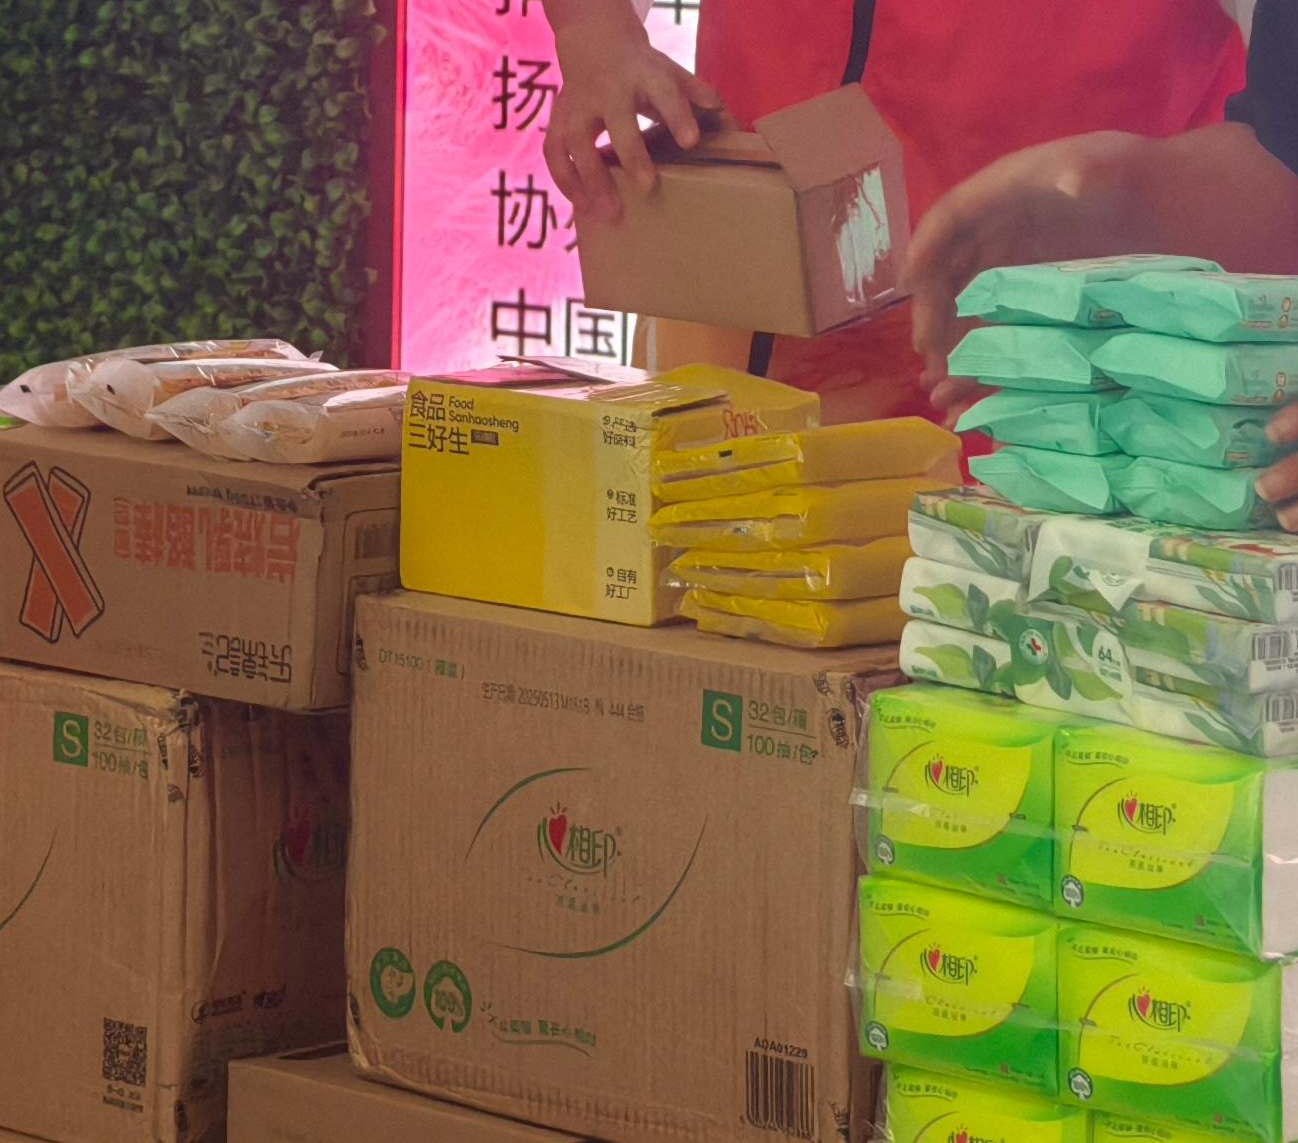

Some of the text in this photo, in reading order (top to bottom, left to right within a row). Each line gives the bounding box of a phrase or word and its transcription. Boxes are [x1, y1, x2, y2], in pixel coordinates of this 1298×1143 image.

[491, 287, 628, 367] 中国
[410, 390, 446, 421] 食品
[448, 395, 475, 411] Food
[448, 409, 520, 433] Sanhaosheng
[408, 422, 470, 456] 三好生
[616, 490, 637, 507] 标准
[606, 506, 638, 524] 好工艺
[616, 568, 637, 585] 自有
[605, 584, 638, 600] 好工厂
[711, 699, 733, 742] S
[61, 719, 83, 758] S
